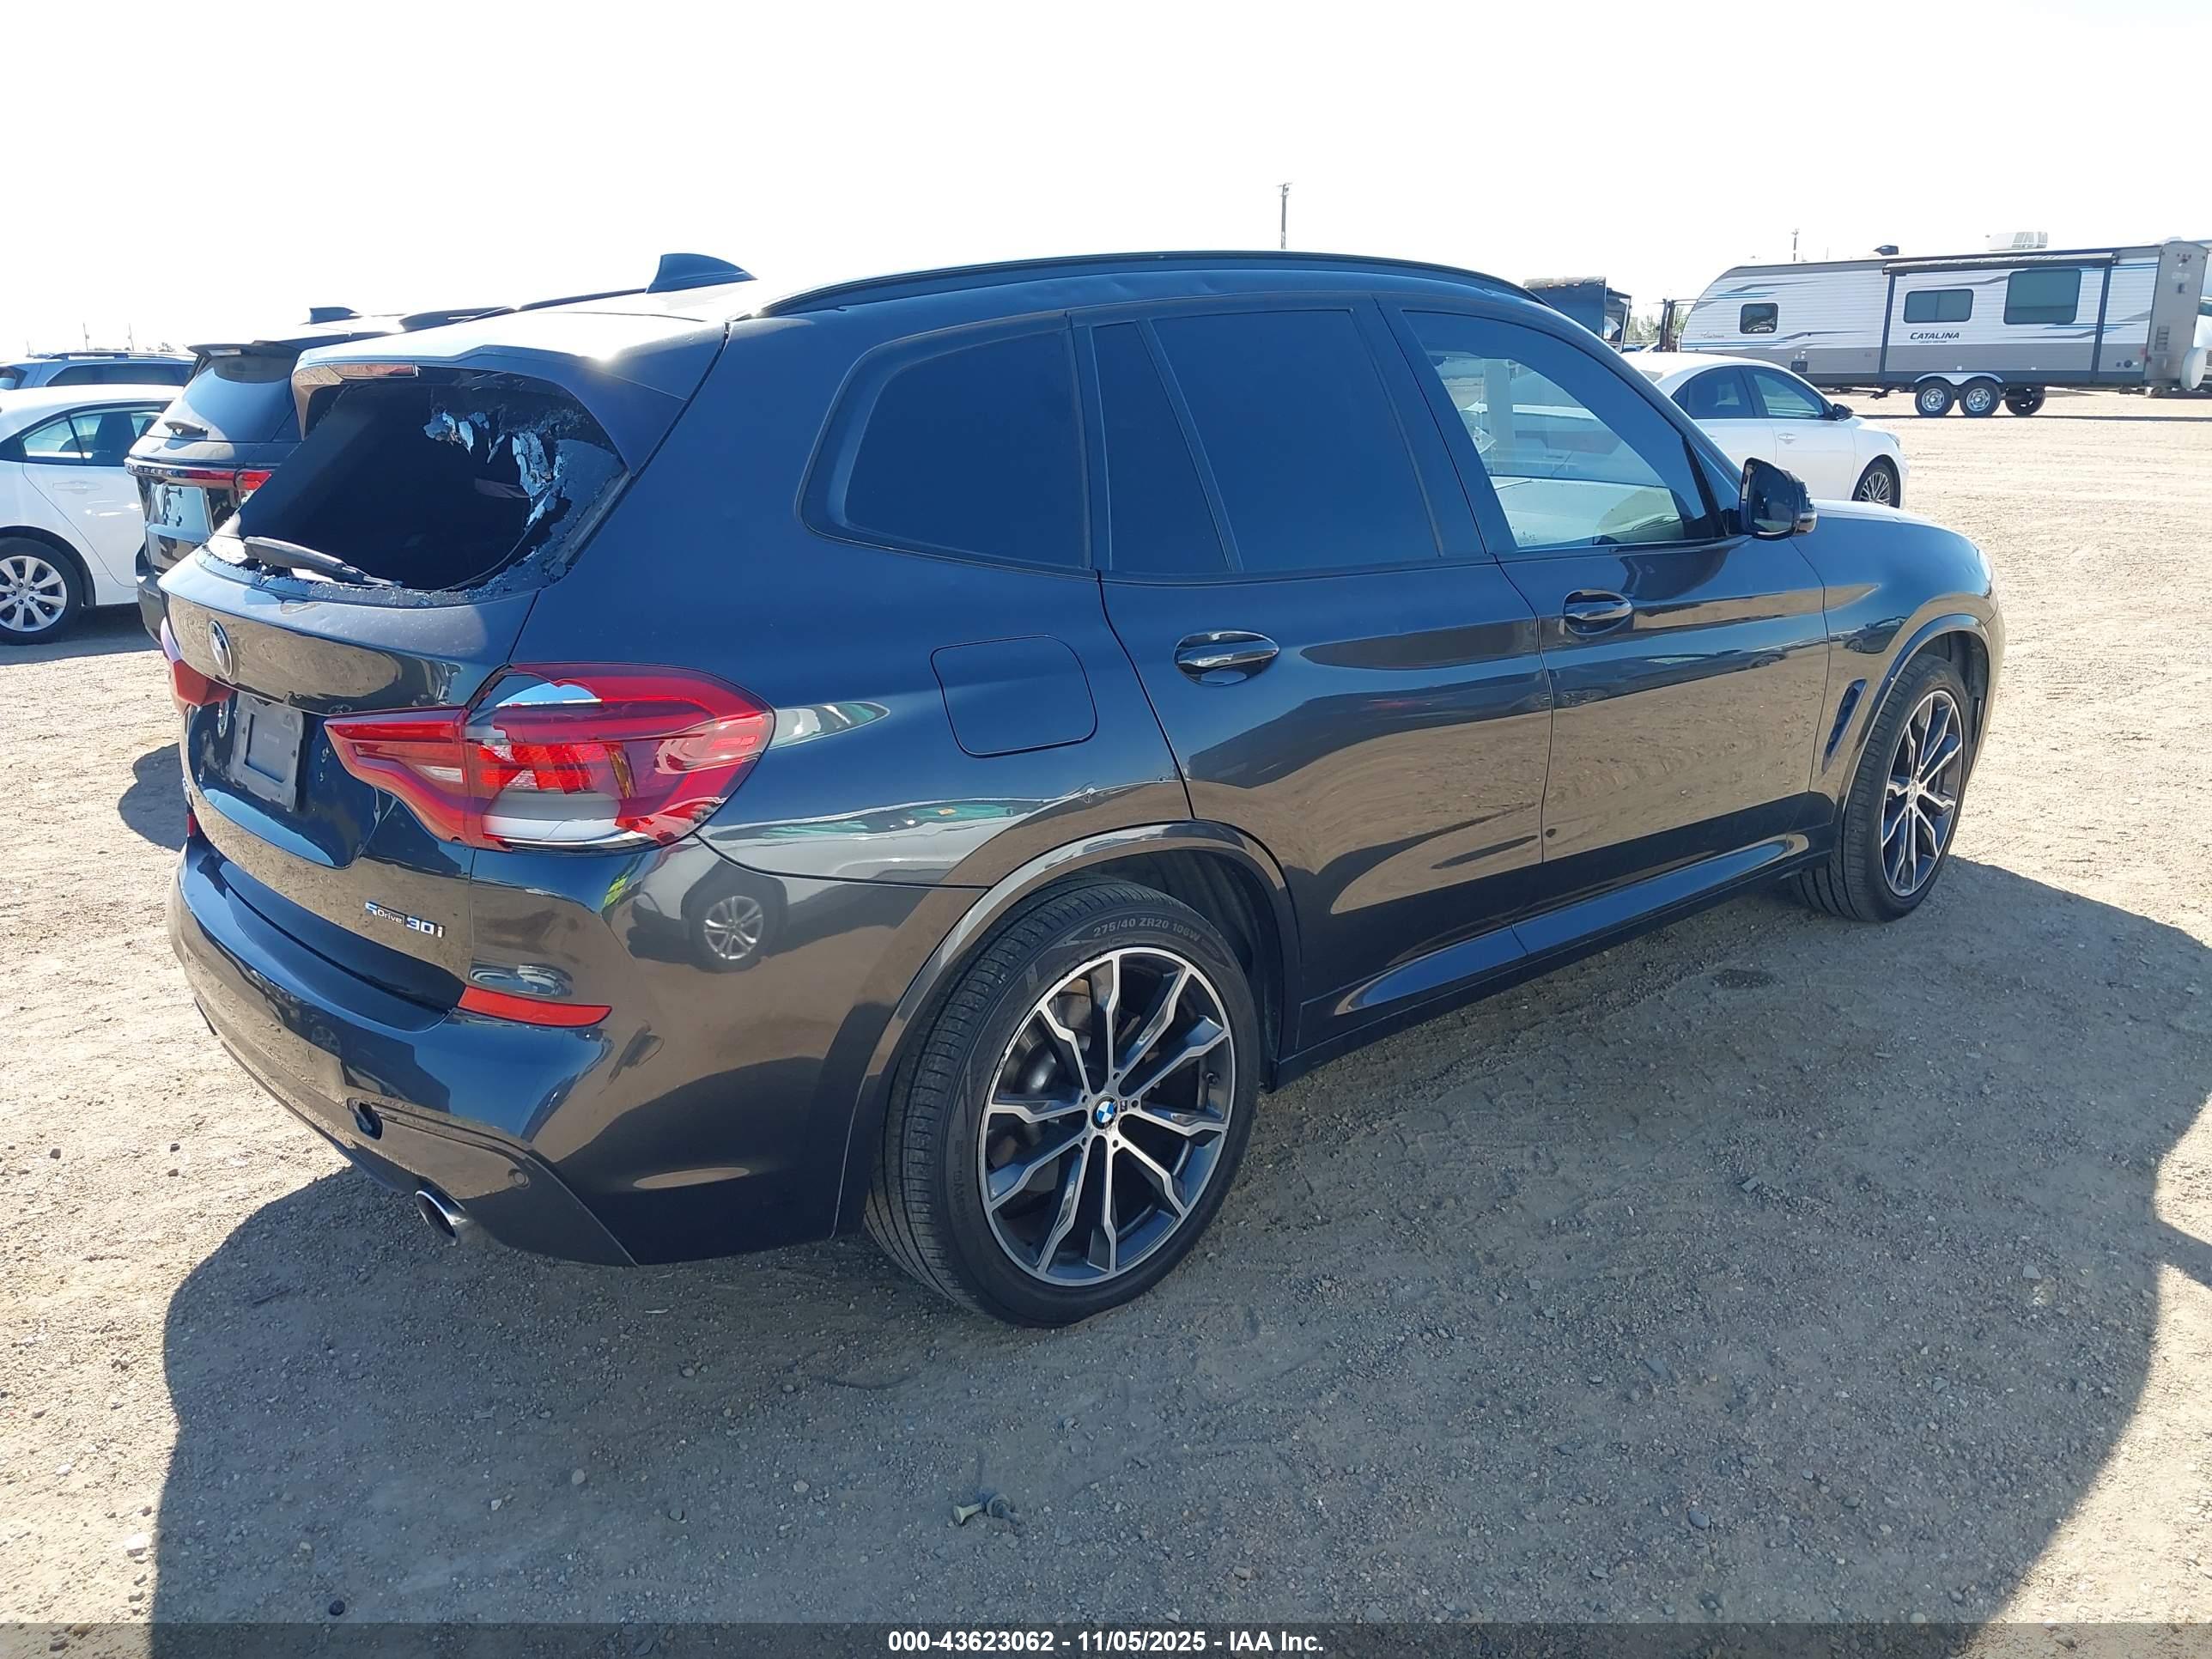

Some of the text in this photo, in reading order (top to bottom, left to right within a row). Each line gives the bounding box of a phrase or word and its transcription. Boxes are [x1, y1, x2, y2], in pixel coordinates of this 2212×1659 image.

[1910, 331, 1960, 340] CATALINA
[1093, 918, 1136, 937] 275/40
[1139, 917, 1170, 929] ZR20
